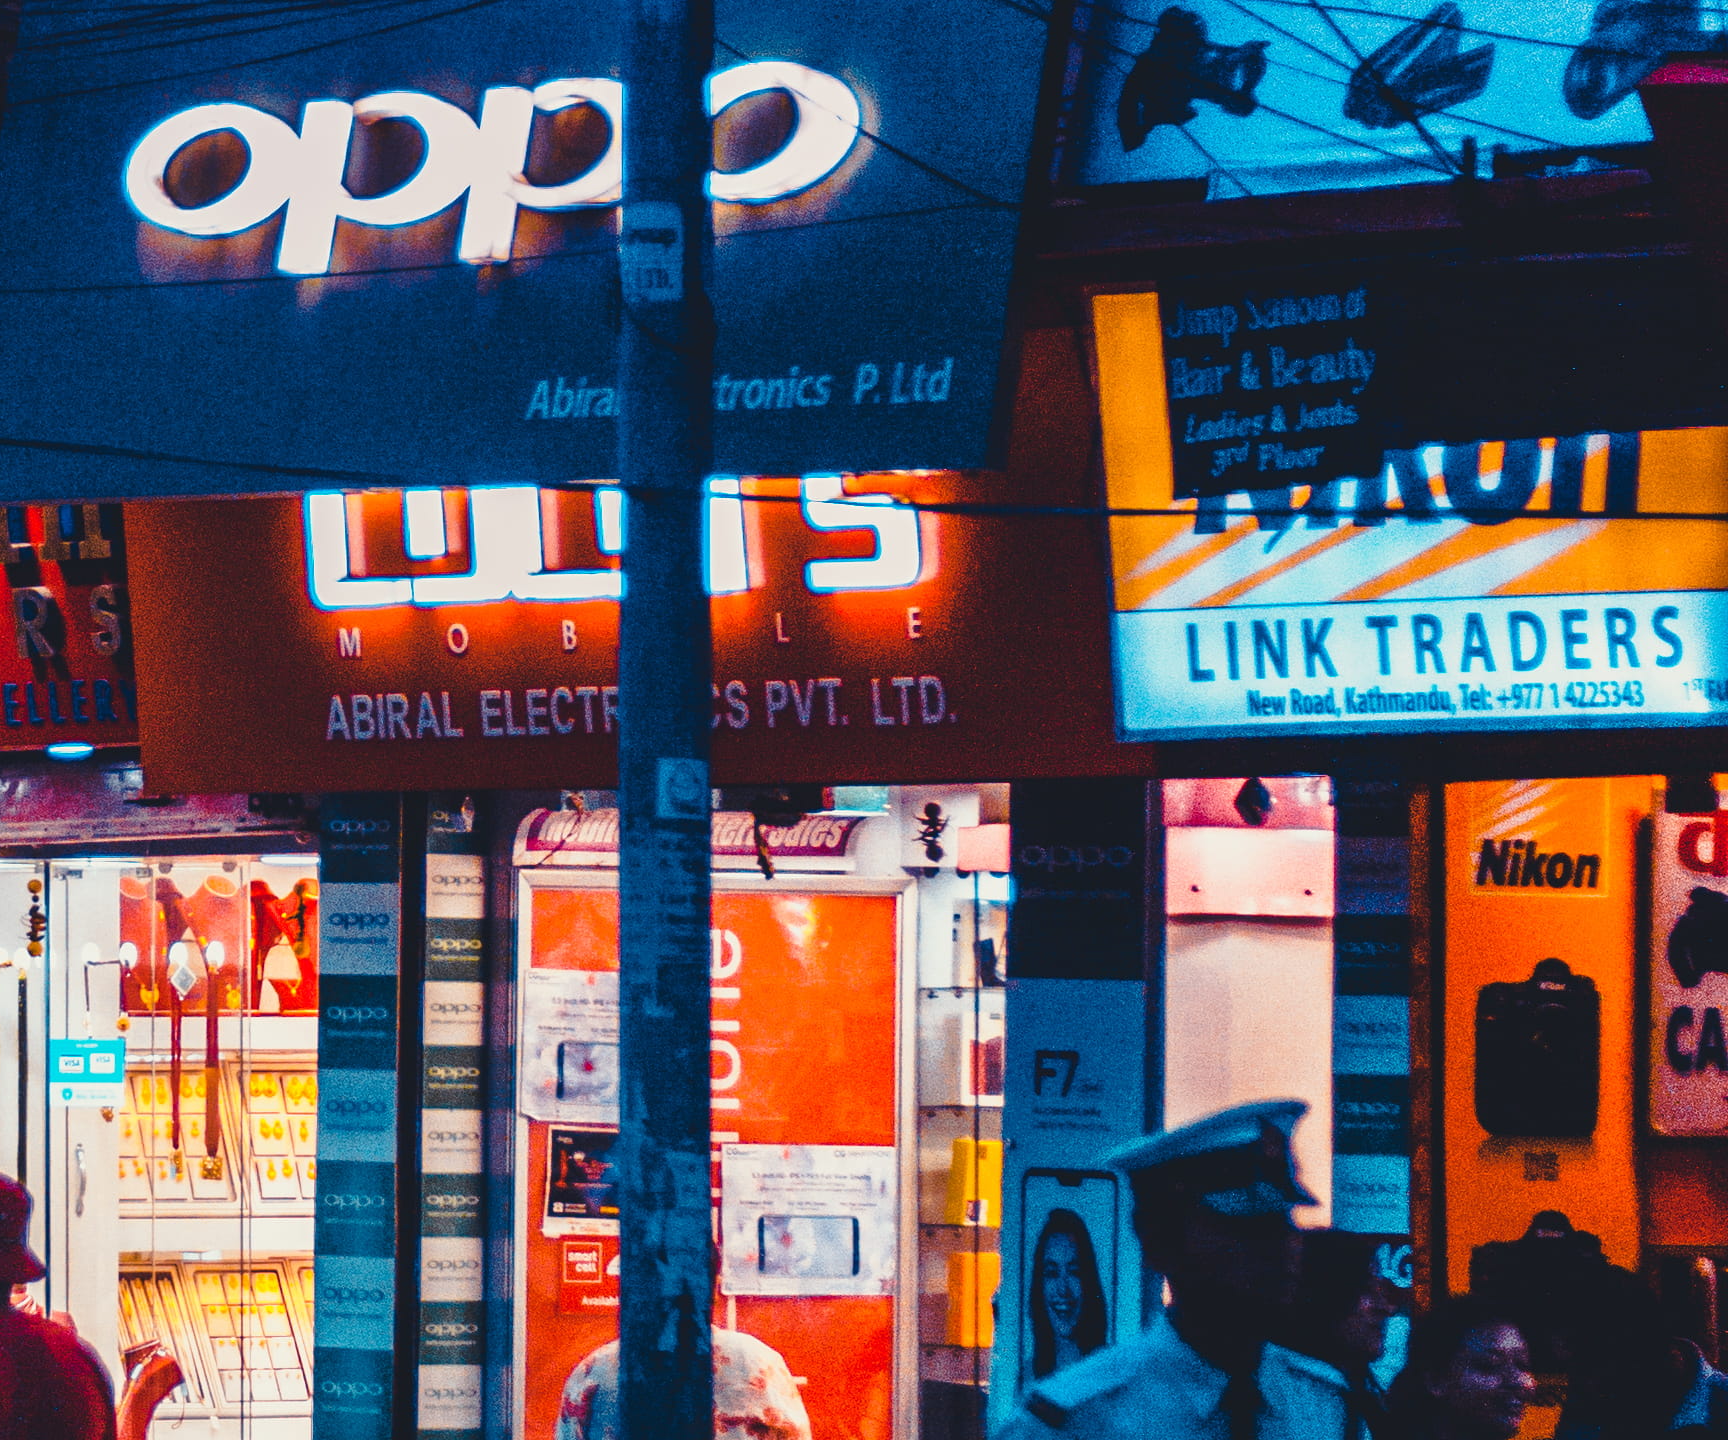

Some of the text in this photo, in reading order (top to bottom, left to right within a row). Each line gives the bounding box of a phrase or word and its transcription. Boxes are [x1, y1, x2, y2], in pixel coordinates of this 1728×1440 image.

[124, 60, 865, 276] oppo
[890, 356, 955, 405] Ltd
[337, 606, 923, 659] MOBLE
[1186, 605, 1685, 682] LINK TRADERS
[325, 691, 464, 742] ABIRAL
[764, 677, 850, 728] PVT.
[871, 675, 958, 726] LTD.
[1247, 689, 1286, 717] New
[1473, 839, 1602, 890] Nikon
[327, 911, 390, 930] oppo
[325, 1004, 388, 1024] oppo
[1033, 1049, 1080, 1098] F7
